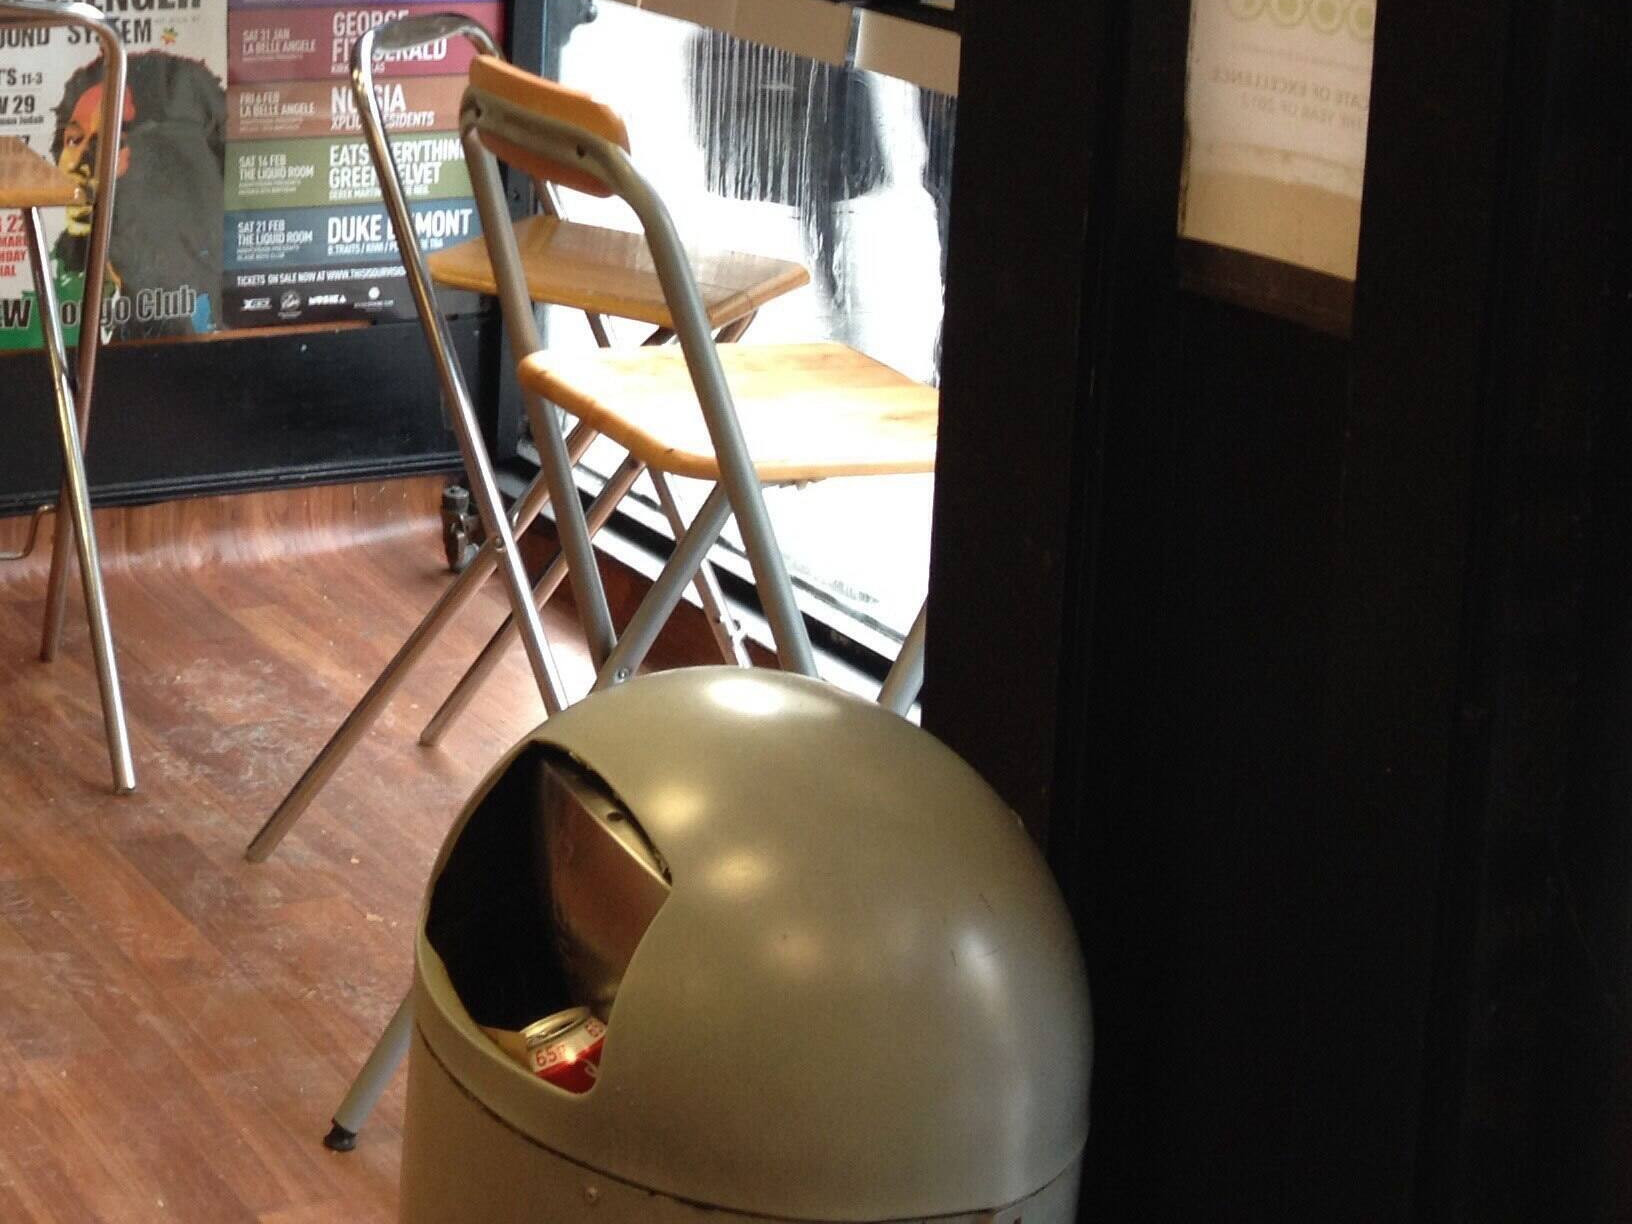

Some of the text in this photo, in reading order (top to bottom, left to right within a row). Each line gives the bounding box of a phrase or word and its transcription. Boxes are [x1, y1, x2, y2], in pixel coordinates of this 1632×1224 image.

[22, 72, 43, 85] 11-3
[13, 94, 35, 114] 29
[330, 142, 368, 166] EATS
[238, 218, 286, 233] SAT 21 FEB
[327, 213, 384, 245] DUKE
[238, 230, 313, 246] THE LIQUID ROOM
[237, 275, 266, 288] TICKETS
[268, 274, 278, 285] ON
[280, 273, 297, 285] SALE
[298, 271, 317, 284] NOW
[136, 284, 198, 322] Club
